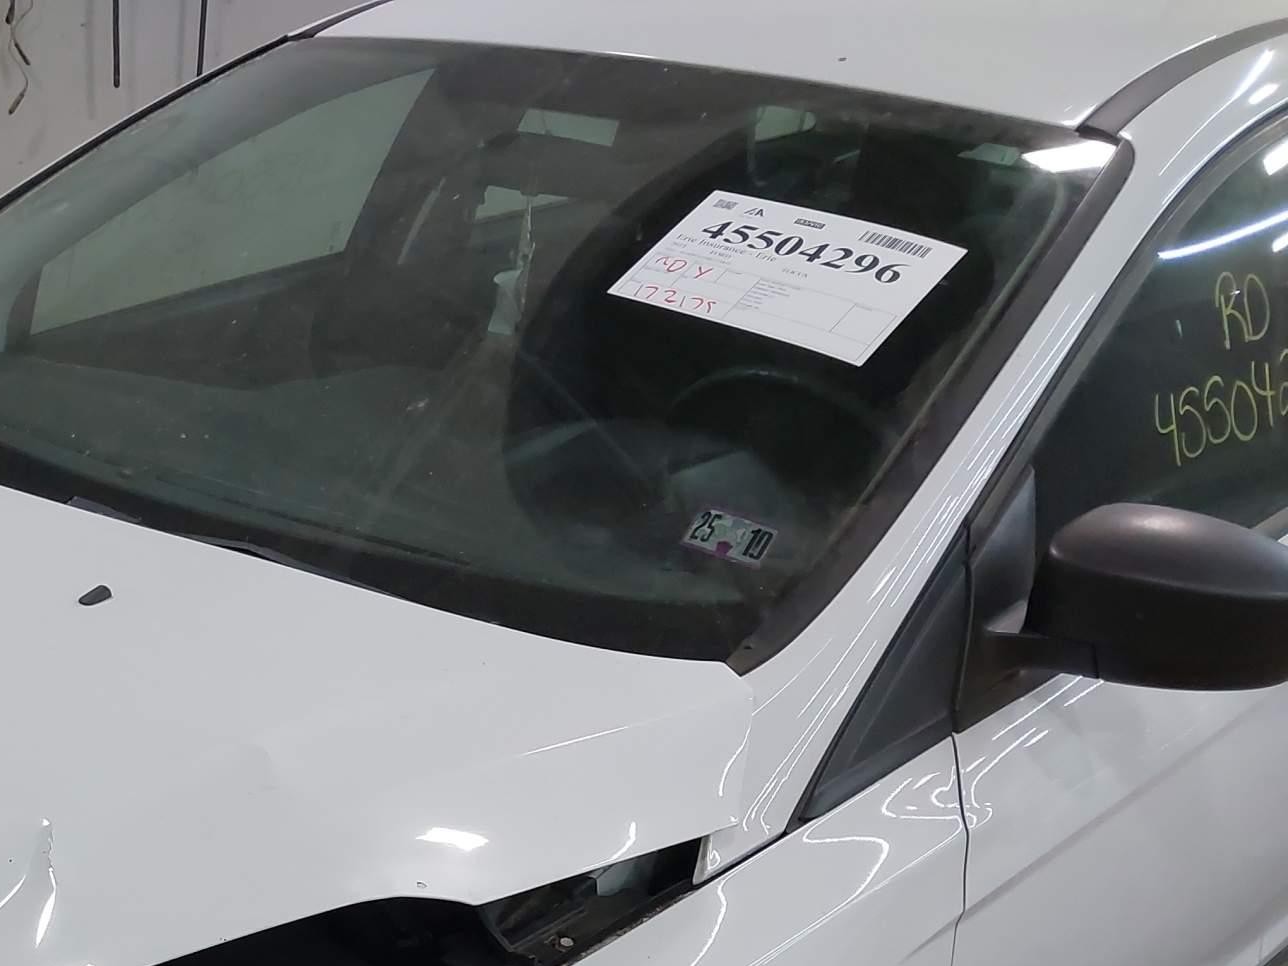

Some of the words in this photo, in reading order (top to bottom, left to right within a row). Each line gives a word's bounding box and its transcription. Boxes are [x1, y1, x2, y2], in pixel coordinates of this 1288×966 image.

[702, 221, 912, 284] 45504296
[1215, 271, 1271, 350] RD
[690, 511, 723, 543] 25
